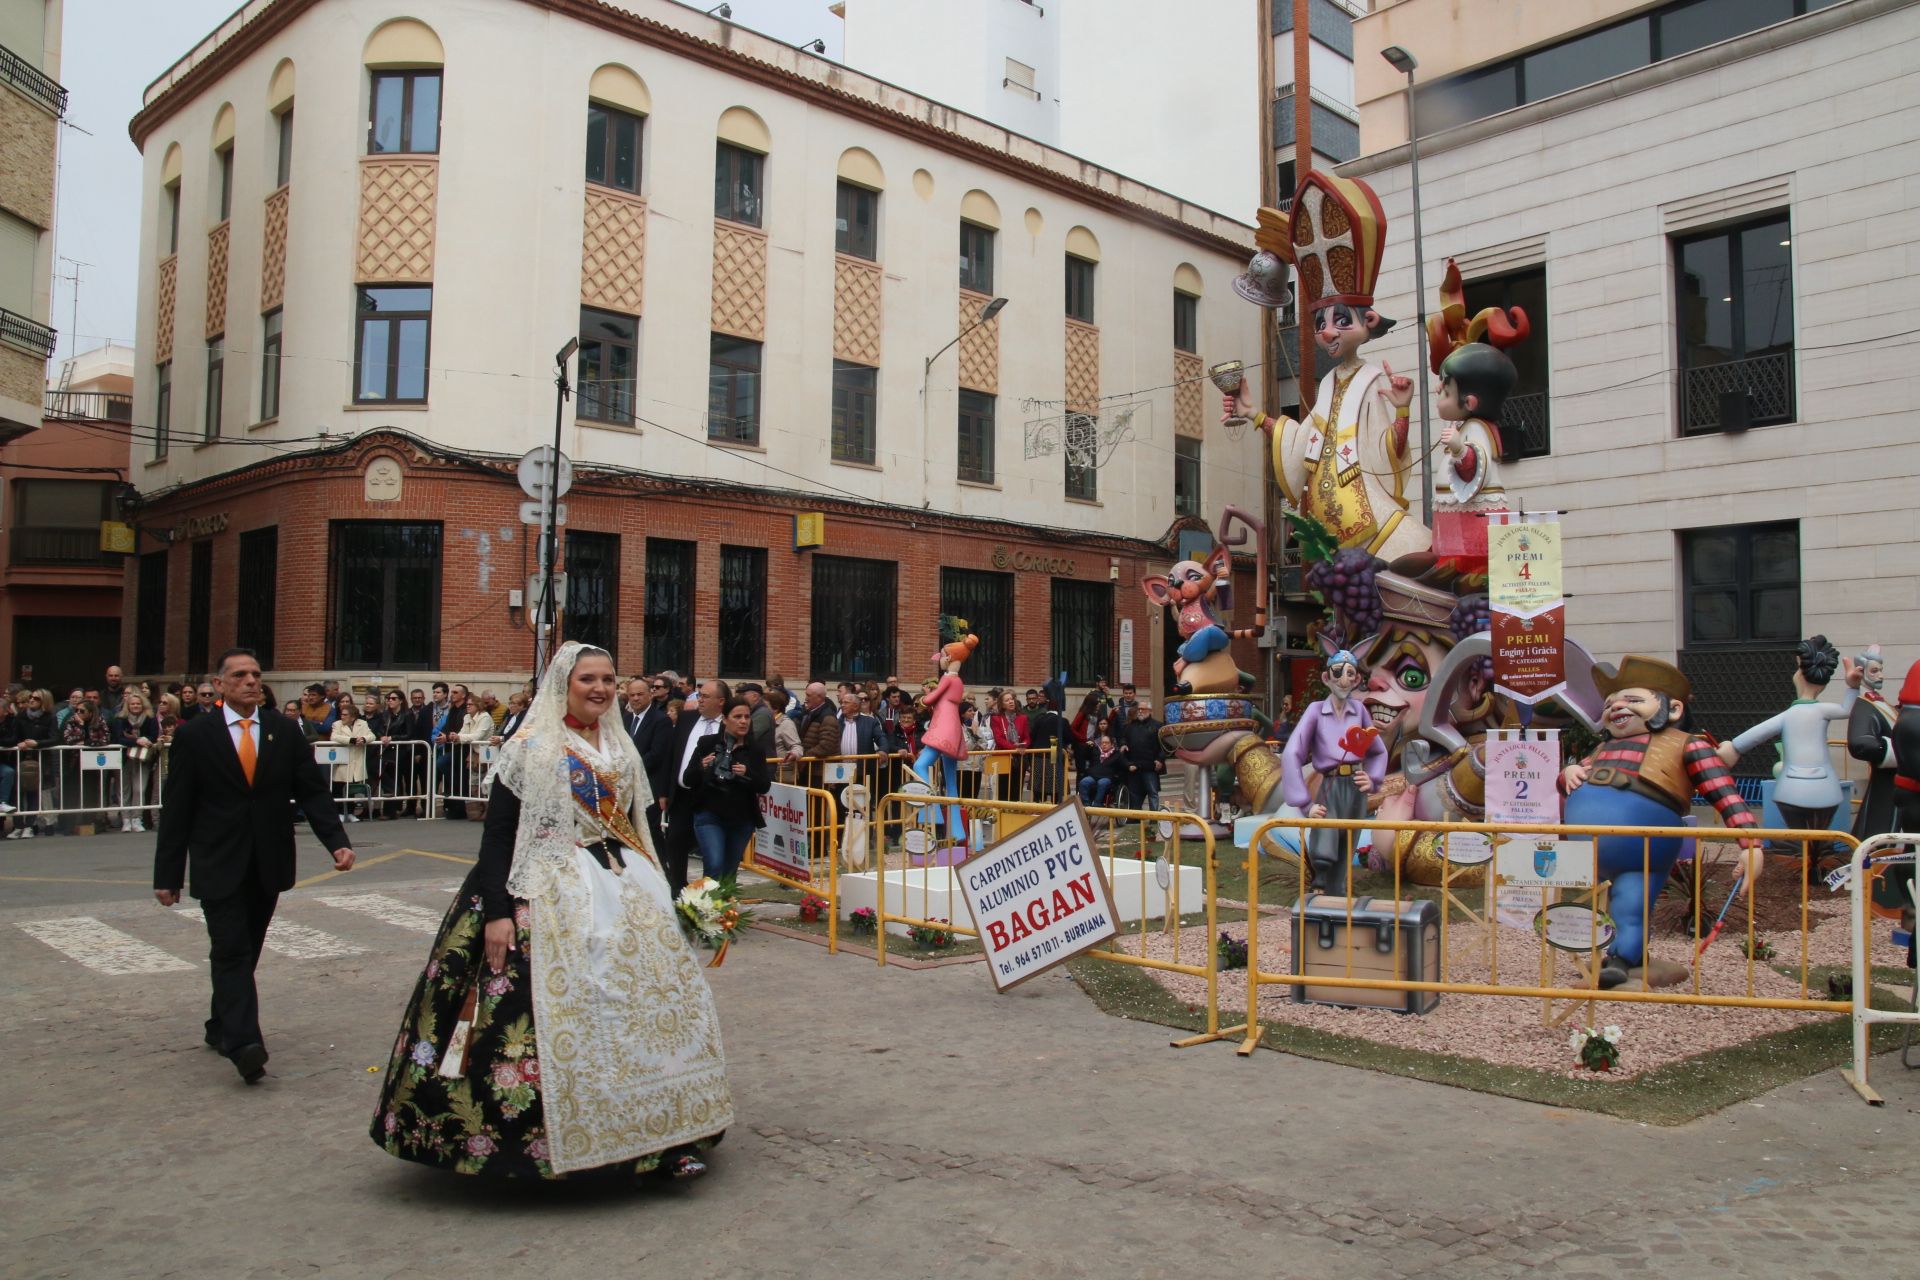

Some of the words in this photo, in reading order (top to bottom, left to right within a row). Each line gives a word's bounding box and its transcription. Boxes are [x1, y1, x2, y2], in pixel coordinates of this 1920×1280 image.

[1507, 553, 1543, 562] PREMI
[1518, 562, 1532, 580] 4
[1507, 634, 1549, 645] PREMI
[1499, 648, 1525, 658] Enginy
[1527, 647, 1530, 655] i
[1531, 646, 1557, 655] Gràcia
[1504, 771, 1540, 779] PREMI
[1515, 780, 1528, 799] 2
[768, 795, 804, 825] Persibur
[969, 834, 1054, 892] CARPINTERIA
[1056, 820, 1077, 842] DE
[980, 869, 1040, 915] ALUMINIO
[1044, 842, 1083, 880] PVC
[986, 872, 1096, 953] BAGAN
[999, 960, 1015, 976] Tel.
[1015, 953, 1031, 968] 964
[1064, 913, 1106, 944] BURRIANA
